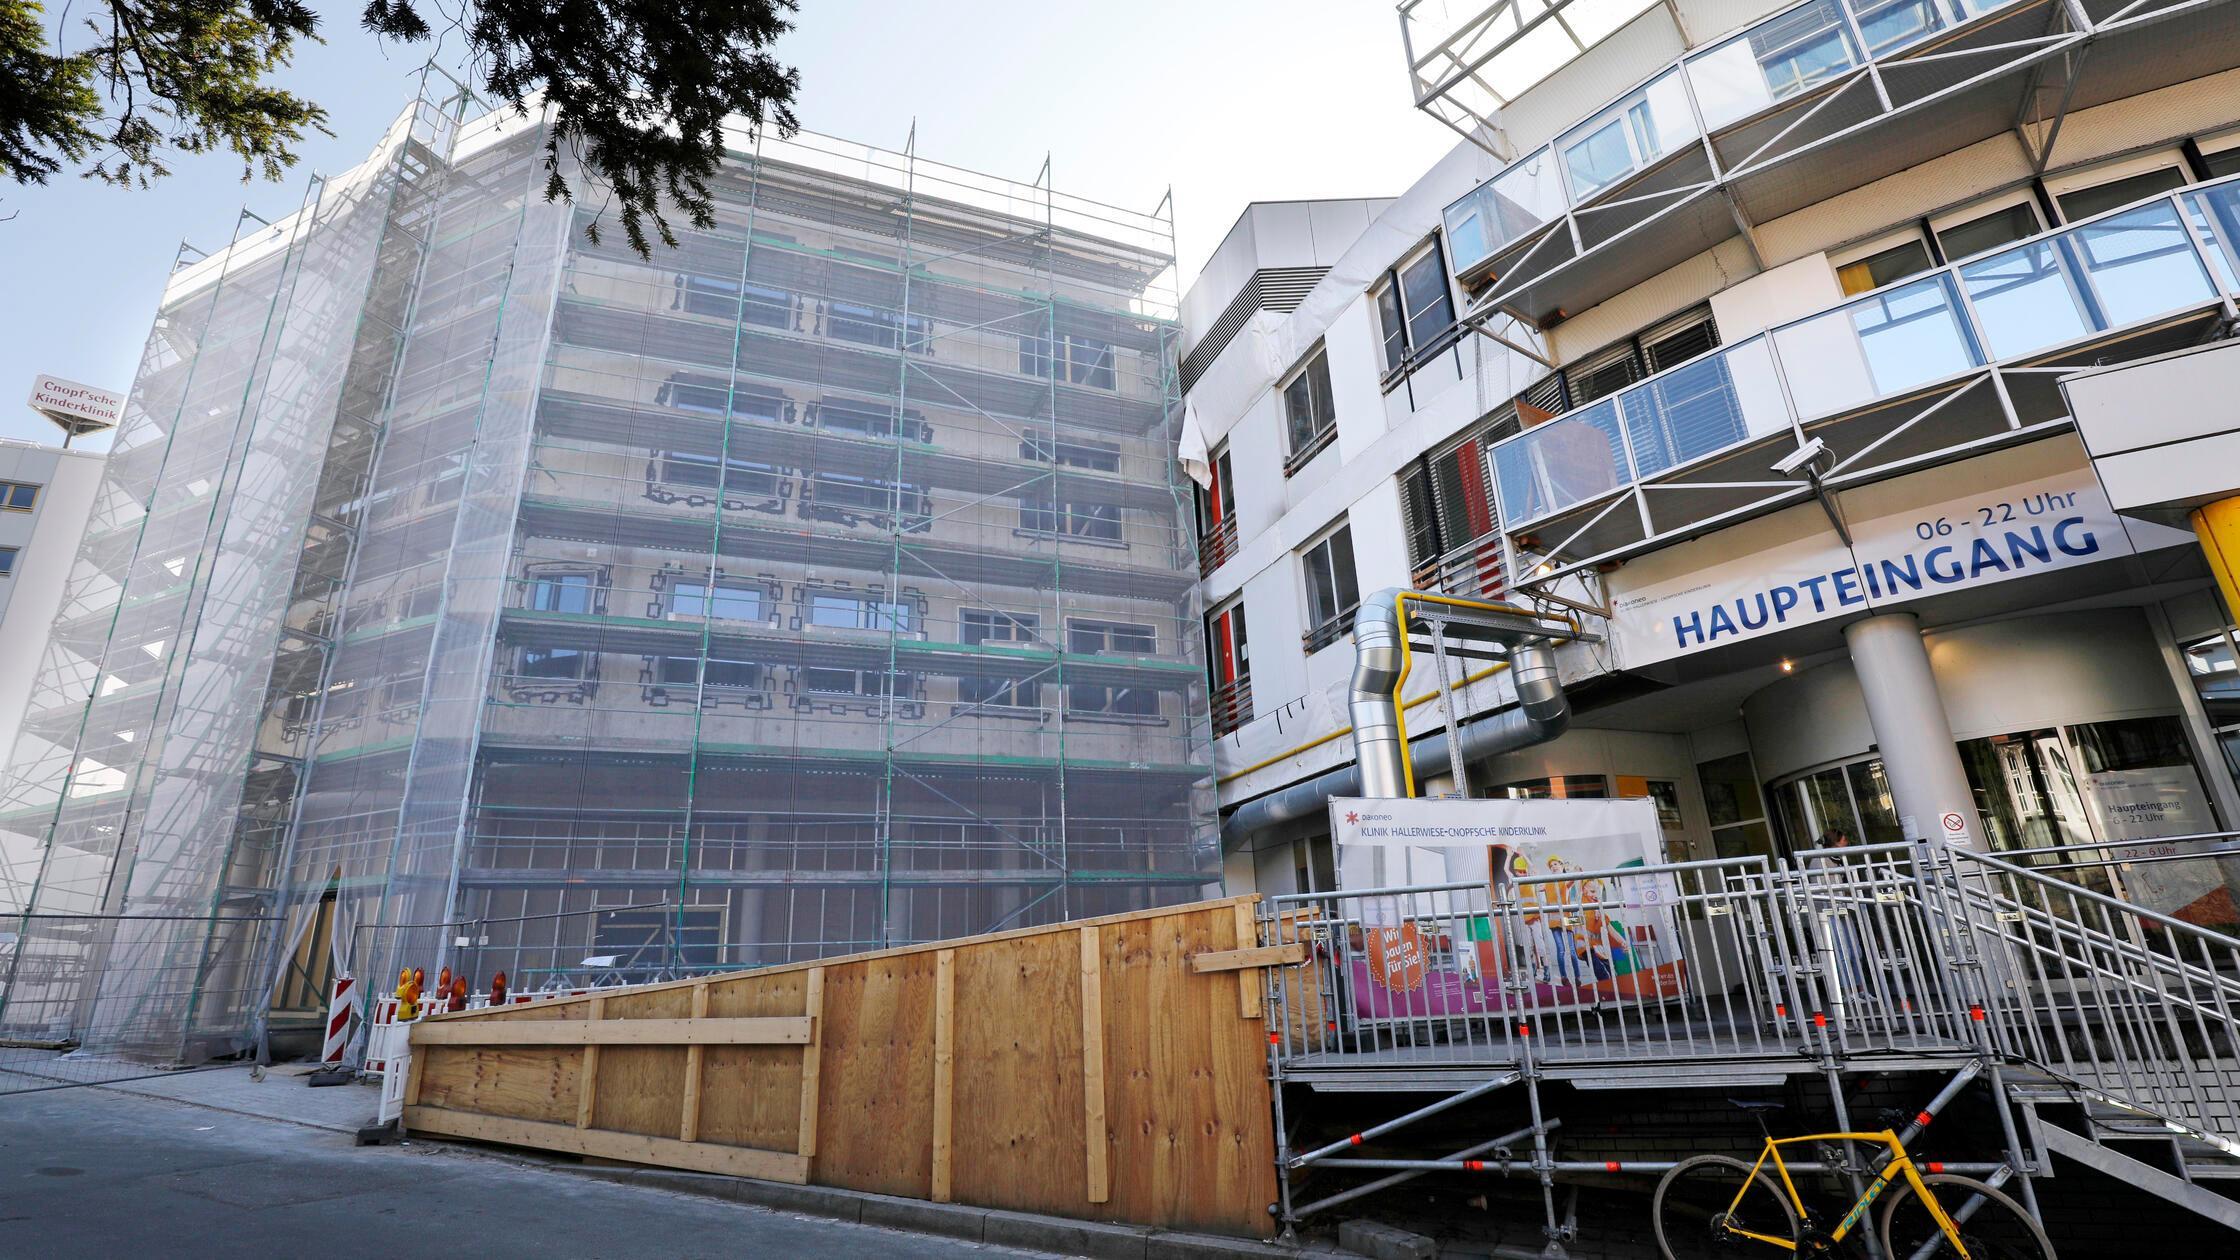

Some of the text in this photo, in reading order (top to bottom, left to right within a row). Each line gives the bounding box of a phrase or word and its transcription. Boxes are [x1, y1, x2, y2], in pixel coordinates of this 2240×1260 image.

[35, 392, 117, 420] Kinderklinik
[44, 381, 117, 406] Cnopf'sche
[1916, 517, 1952, 540] 06
[1978, 503, 2016, 527] 22
[2023, 492, 2076, 515] Uhr
[1672, 516, 2100, 649] HAUPTEINGANG
[2108, 801, 2182, 814] Haupteingang
[2113, 816, 2120, 825] 6
[2129, 815, 2143, 824] 22
[2145, 813, 2164, 822] Uhr
[1361, 827, 1388, 837] KLINIK
[1498, 826, 1547, 837] KINDERKLINIK
[2124, 849, 2138, 858] 22
[2149, 847, 2156, 856] 6
[2158, 846, 2177, 855] Uhr
[1843, 1181, 1884, 1232] RIDLEY
